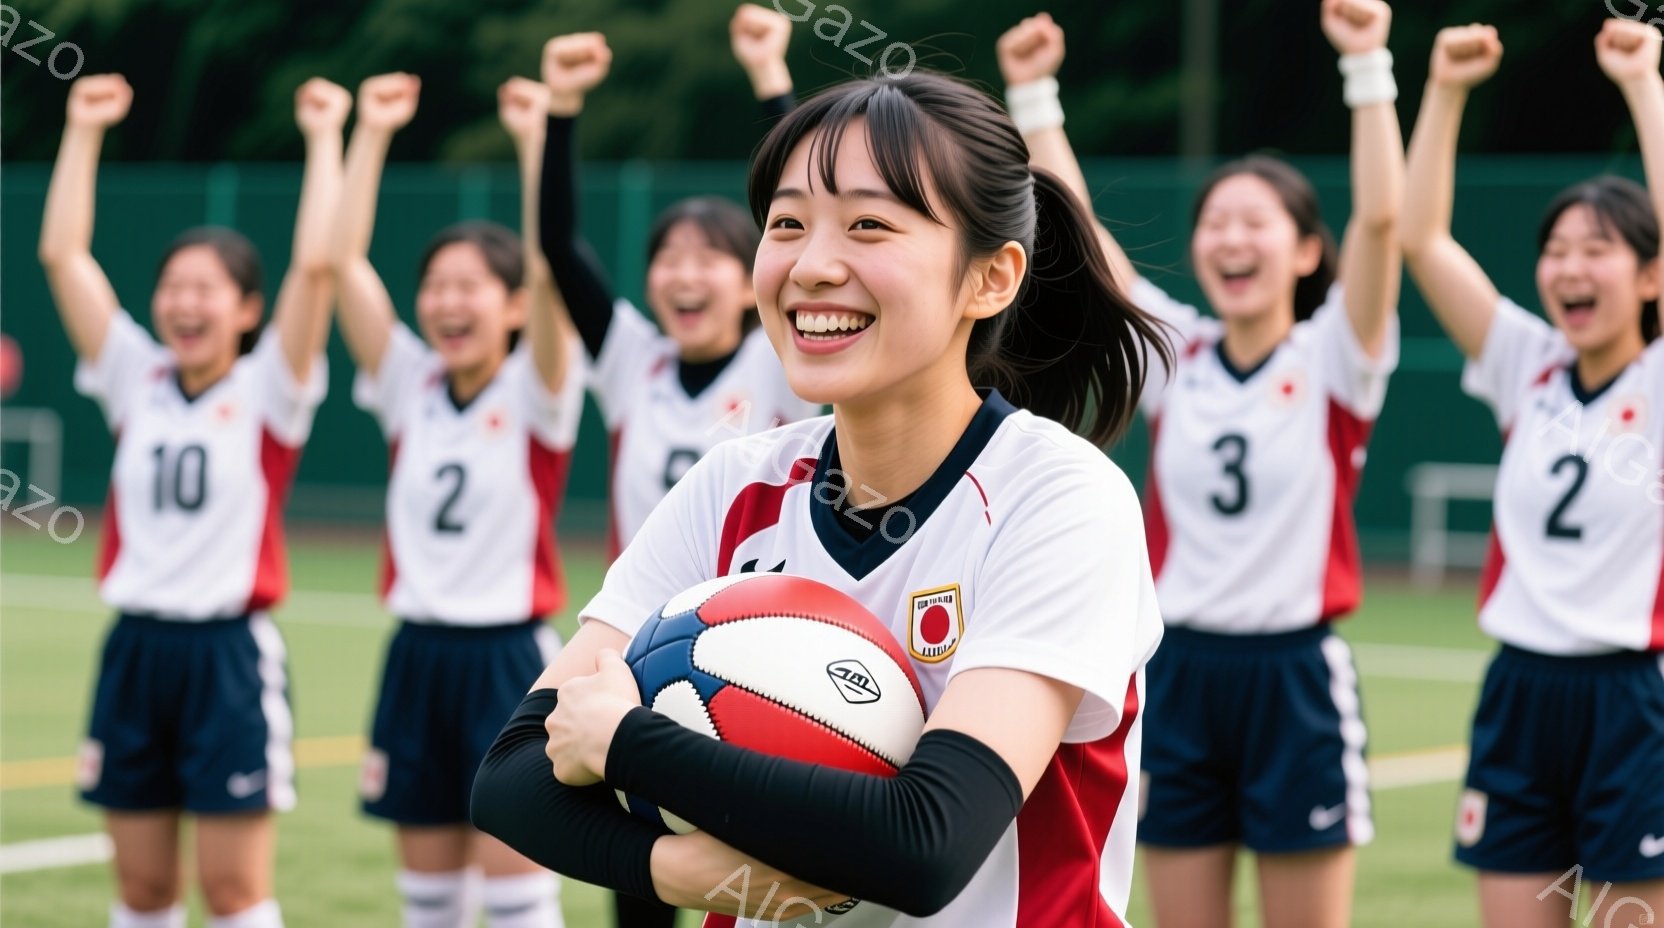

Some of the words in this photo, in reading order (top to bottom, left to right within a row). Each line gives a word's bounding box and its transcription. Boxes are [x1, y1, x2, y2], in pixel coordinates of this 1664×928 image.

[152, 443, 208, 514] 10
[434, 462, 466, 533] 2
[1211, 432, 1248, 516] 3
[1547, 453, 1589, 539] 2
